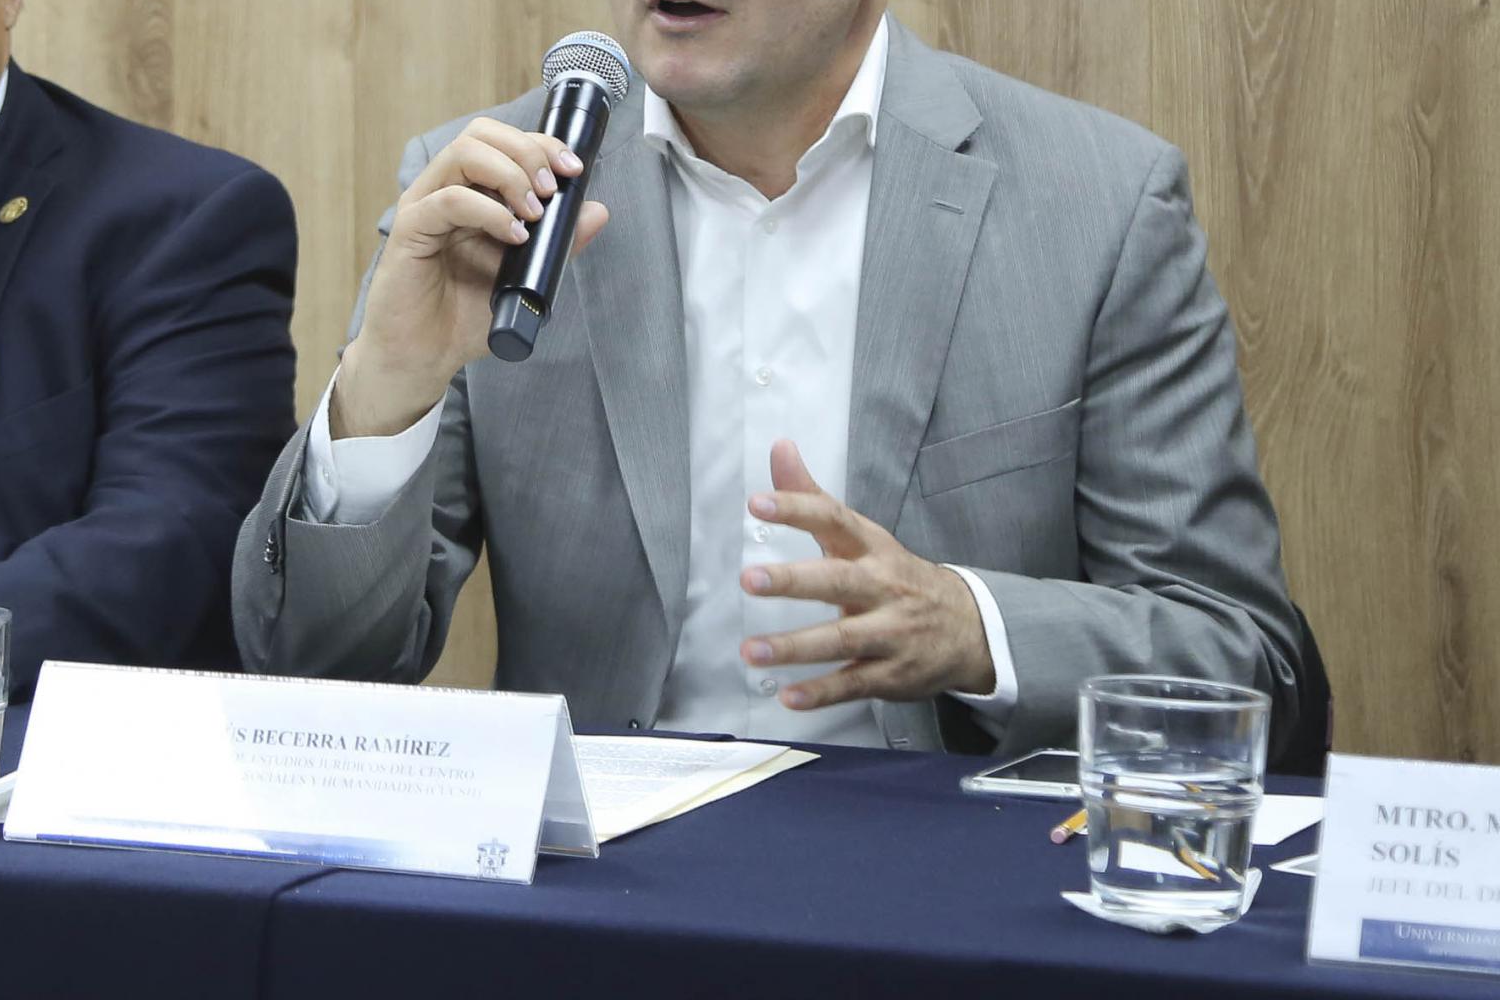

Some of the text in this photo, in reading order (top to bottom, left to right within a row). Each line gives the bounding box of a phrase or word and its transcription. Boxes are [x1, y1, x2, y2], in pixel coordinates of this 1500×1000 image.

[252, 728, 347, 750] BECERRA
[355, 734, 451, 758] RAMÍREZ
[419, 766, 476, 781] CENTRO
[1375, 804, 1476, 832] MTRO.
[1371, 840, 1460, 868] SOLÍS
